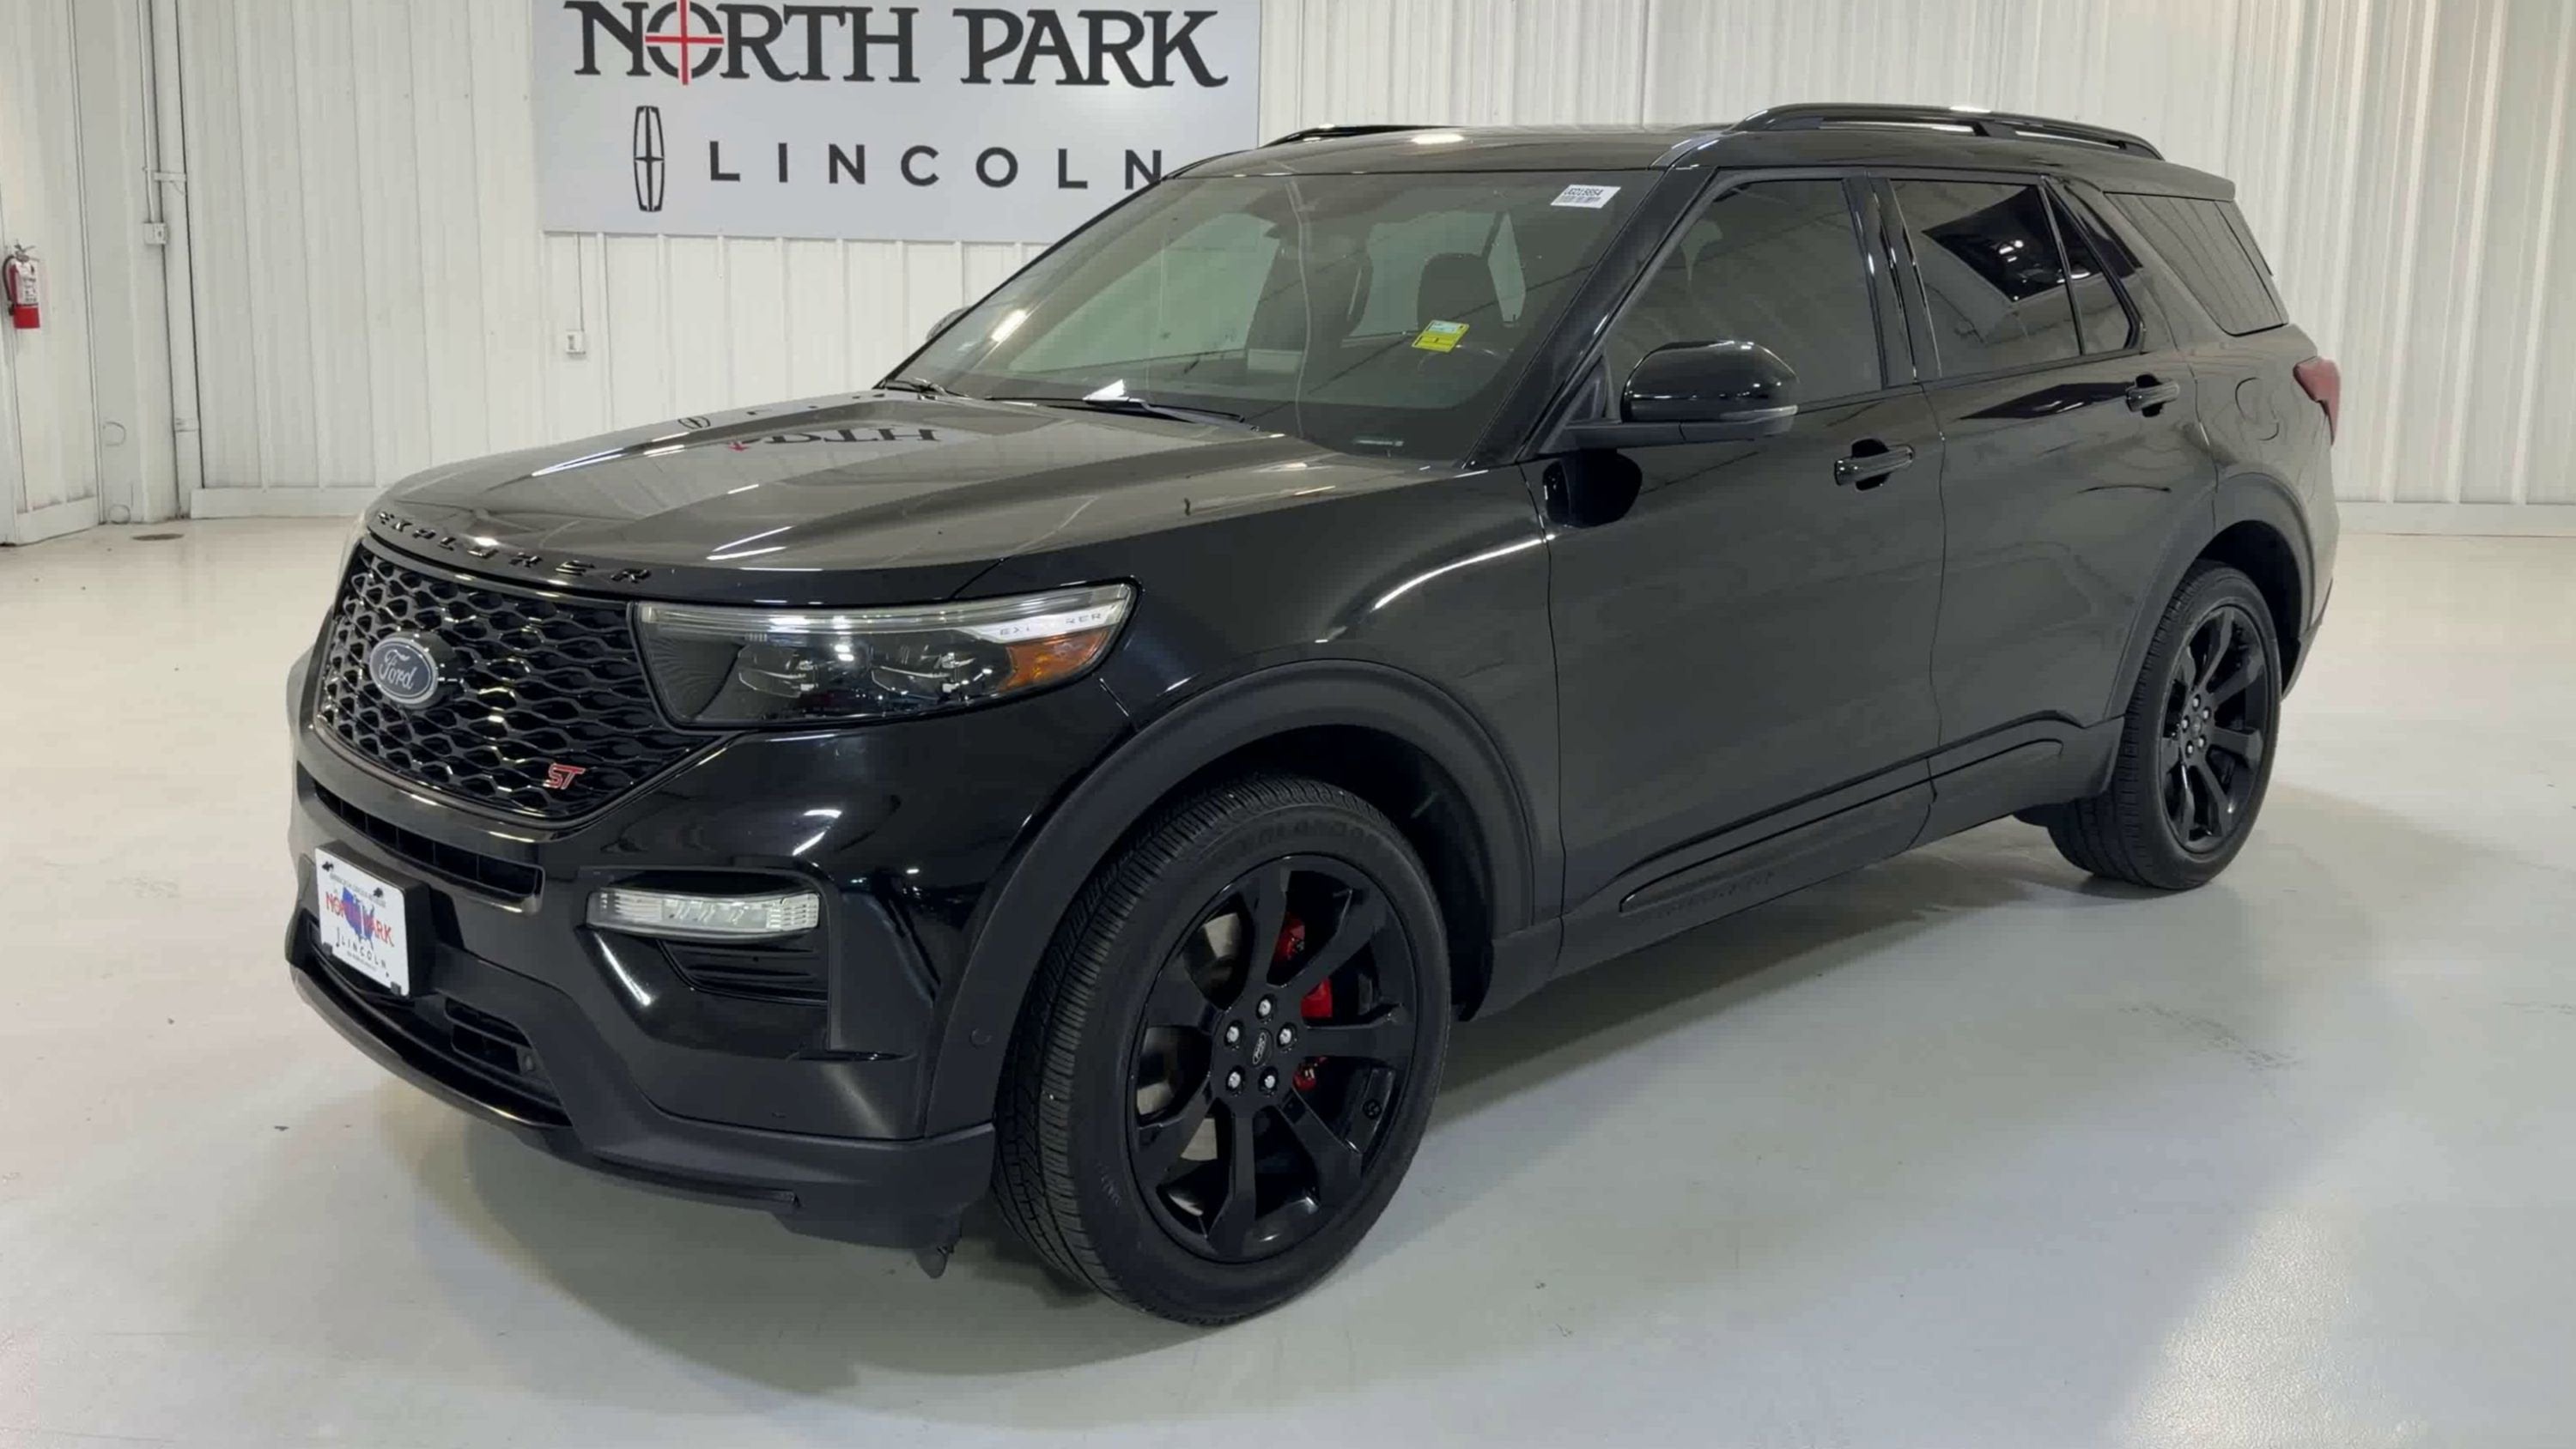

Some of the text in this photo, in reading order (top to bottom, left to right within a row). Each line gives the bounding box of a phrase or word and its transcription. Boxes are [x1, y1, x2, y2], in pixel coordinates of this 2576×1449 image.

[563, 0, 1229, 88] NORTH PARK
[709, 142, 1162, 190] LINCOLN
[379, 649, 417, 690] Ford
[543, 762, 586, 790] ST
